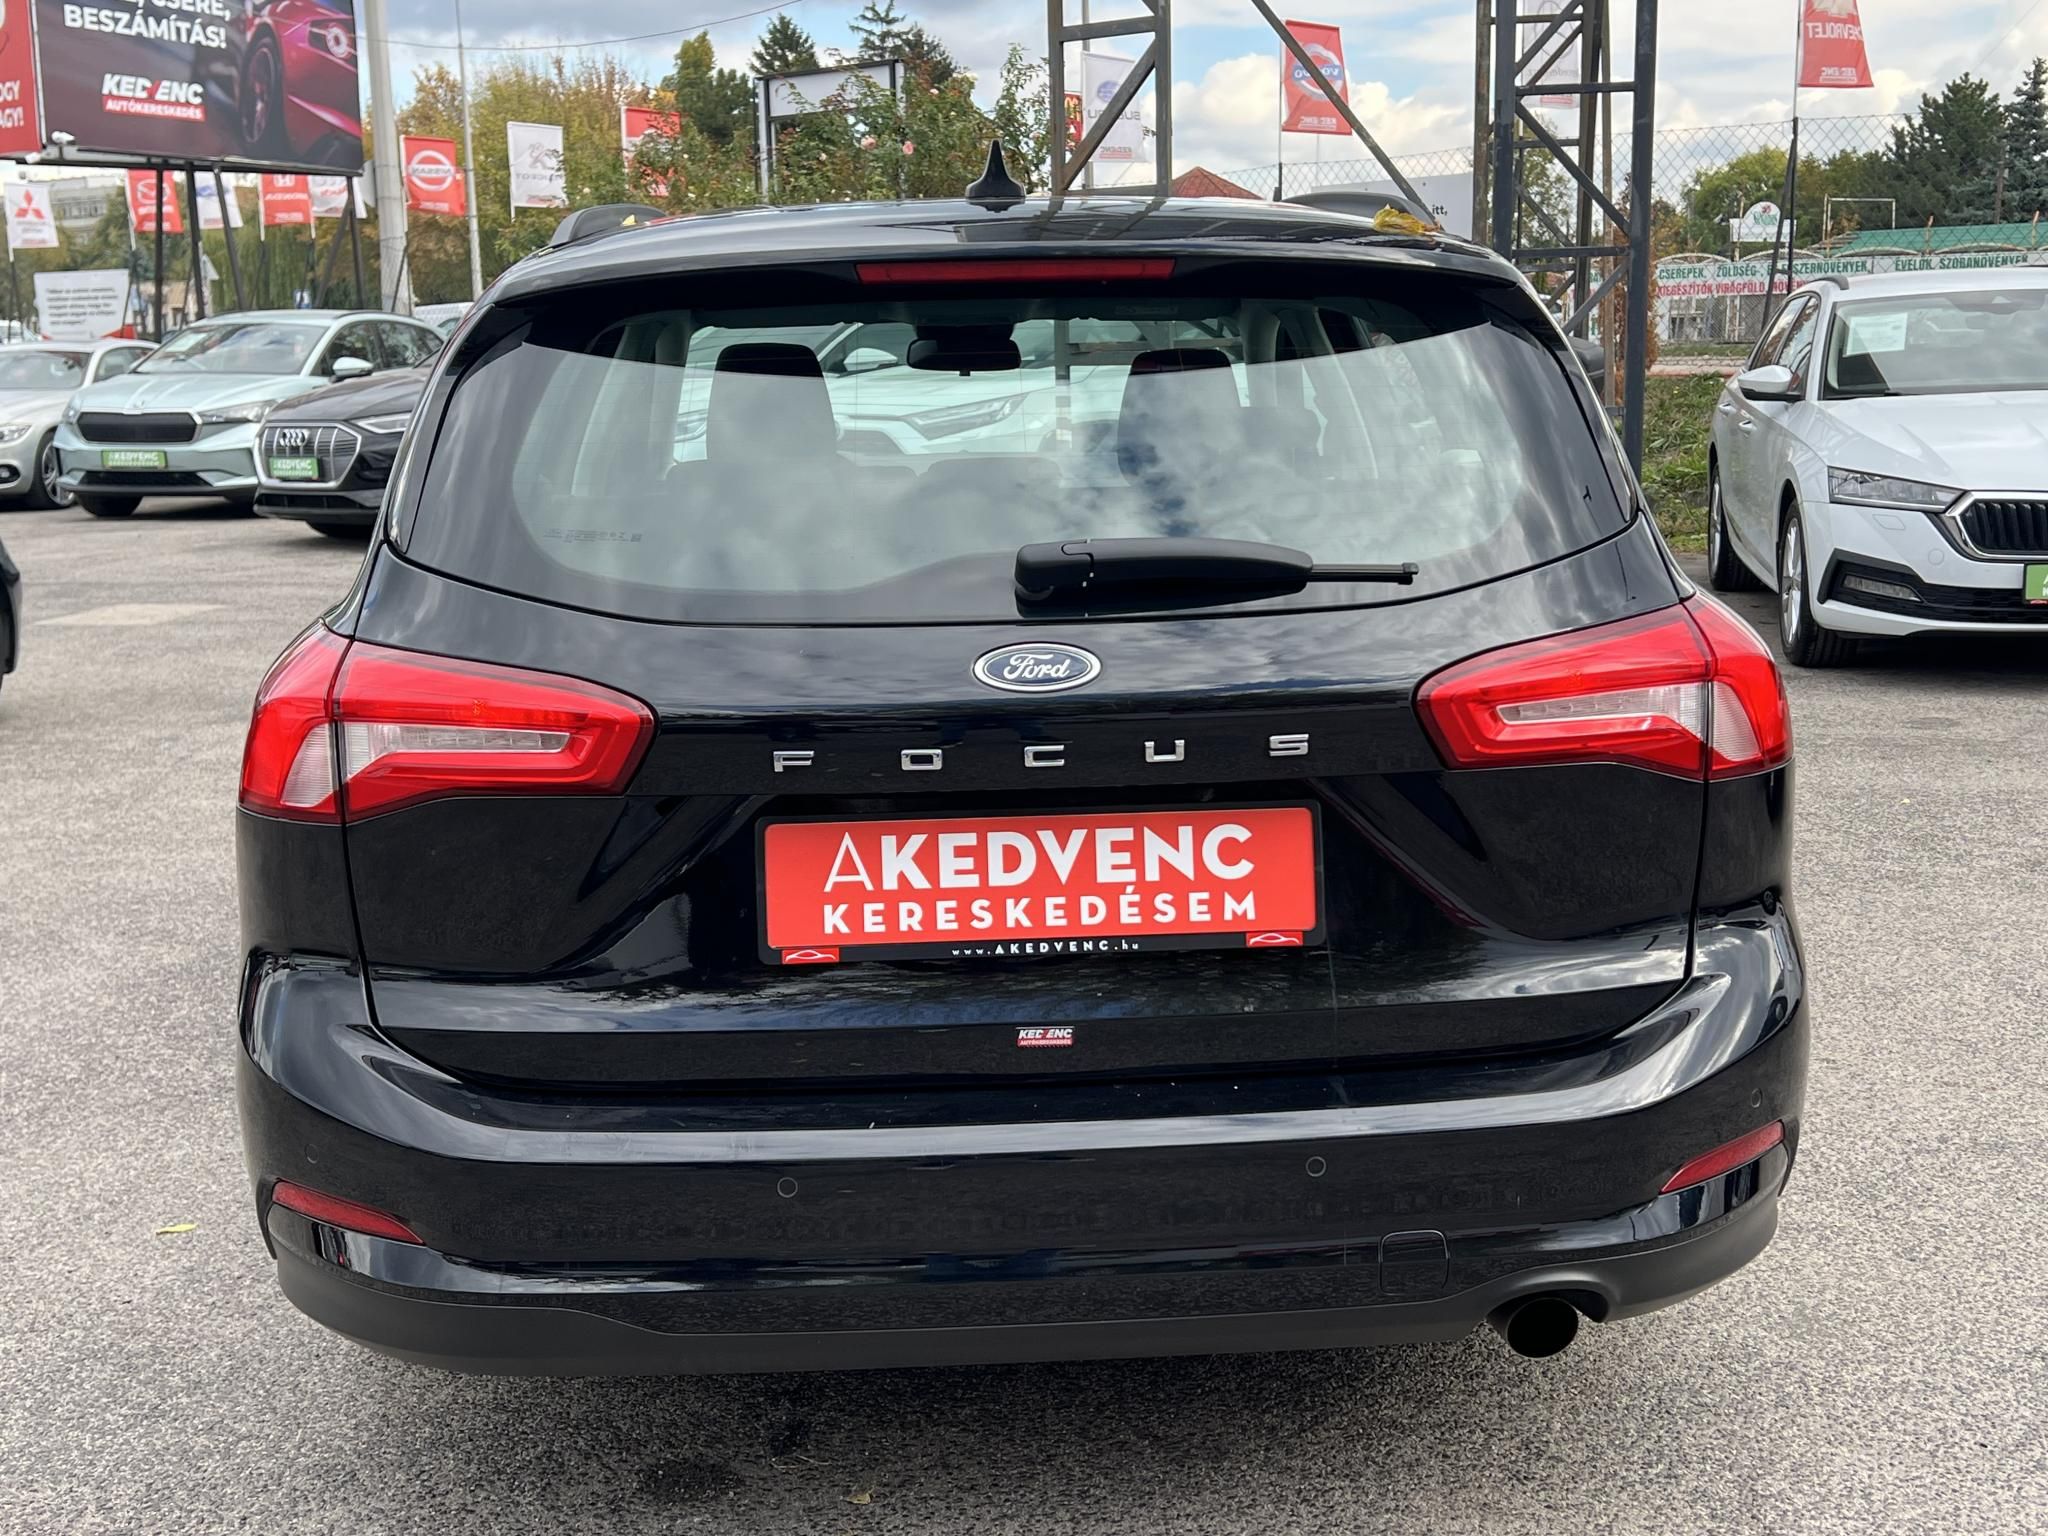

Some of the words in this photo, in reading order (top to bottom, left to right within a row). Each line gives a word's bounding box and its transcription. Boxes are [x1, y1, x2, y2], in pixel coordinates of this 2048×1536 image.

[63, 4, 228, 49] BESZÁMÍTÁS!
[1003, 653, 1071, 680] Ford
[773, 733, 1310, 773] FOCUS
[823, 885, 1257, 935] KERESKEDÉSEM
[952, 939, 1139, 956] www.AKEDVENC.hu
